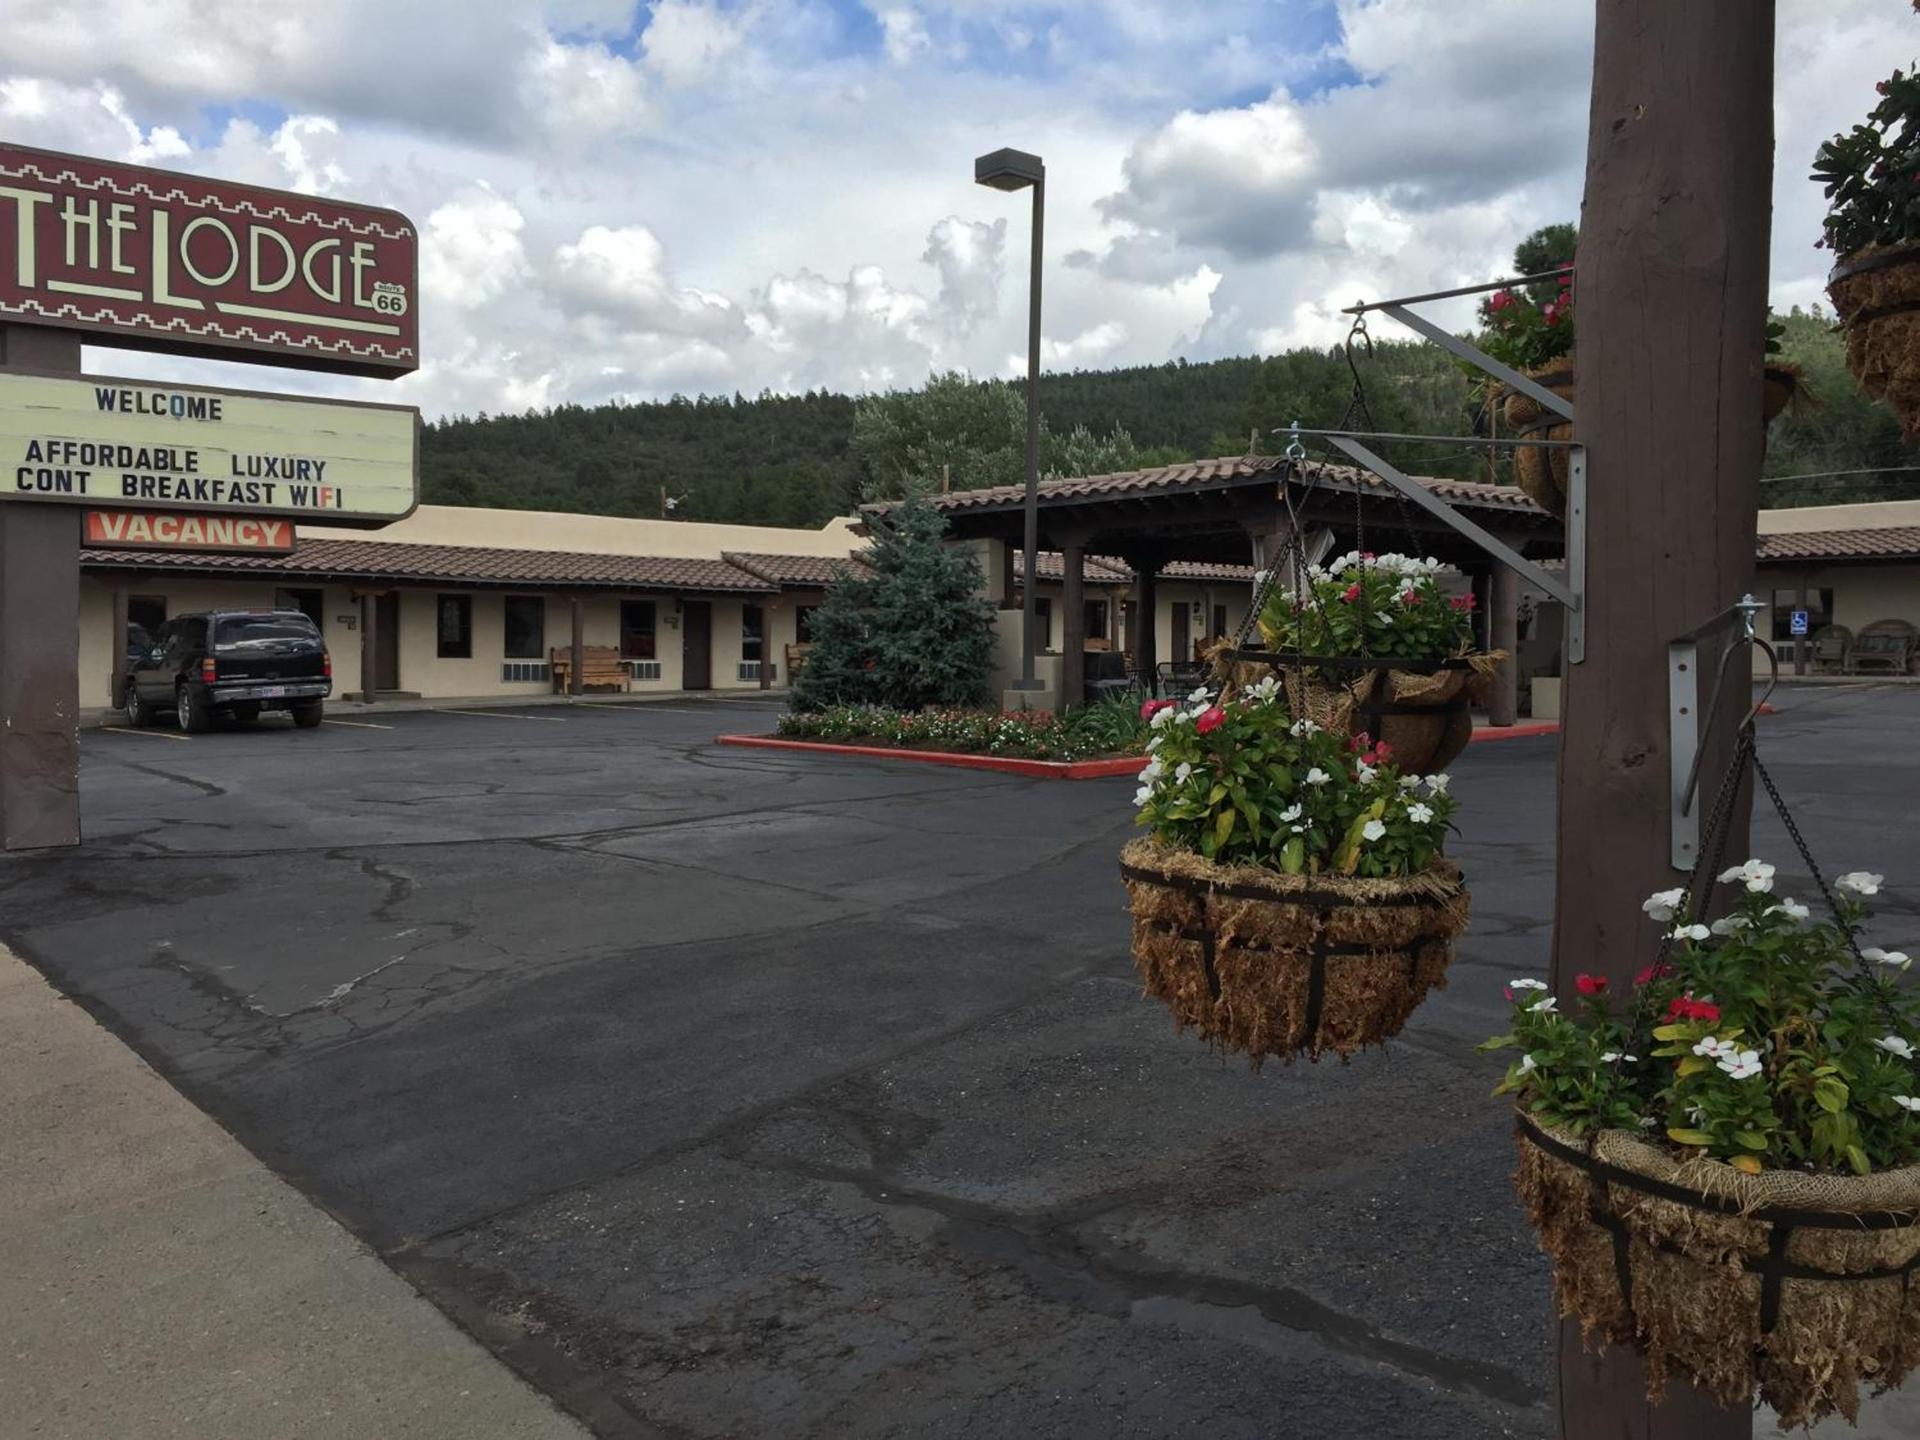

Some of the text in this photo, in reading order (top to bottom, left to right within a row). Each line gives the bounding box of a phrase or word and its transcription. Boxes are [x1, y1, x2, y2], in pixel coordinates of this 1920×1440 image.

[0, 186, 377, 310] THE LODGE
[377, 295, 402, 312] 66
[95, 388, 222, 420] WELCOME
[25, 439, 327, 482] AFFORDABLE LUXURY
[17, 467, 342, 509] CONT BREAKFAST WIFI
[98, 513, 284, 547] VACANCY
